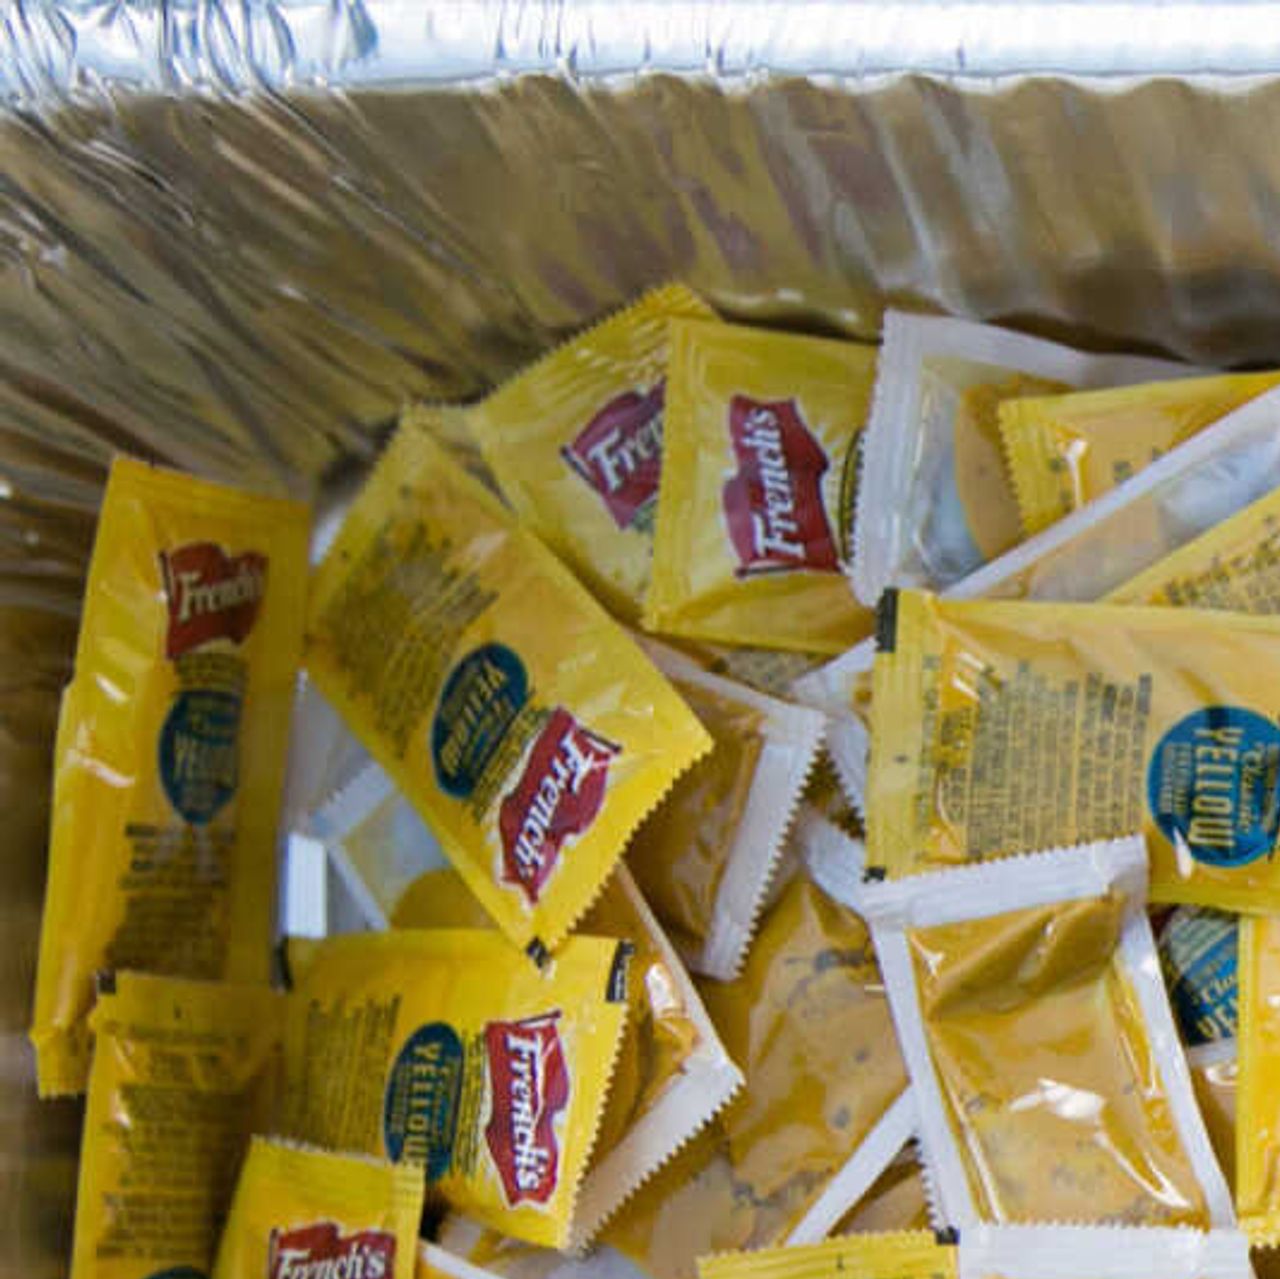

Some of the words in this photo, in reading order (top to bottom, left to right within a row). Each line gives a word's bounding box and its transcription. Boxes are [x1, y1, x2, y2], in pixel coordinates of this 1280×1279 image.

[742, 407, 805, 559] French's
[1189, 727, 1244, 849] YELLOW
[507, 1031, 550, 1191] French's
